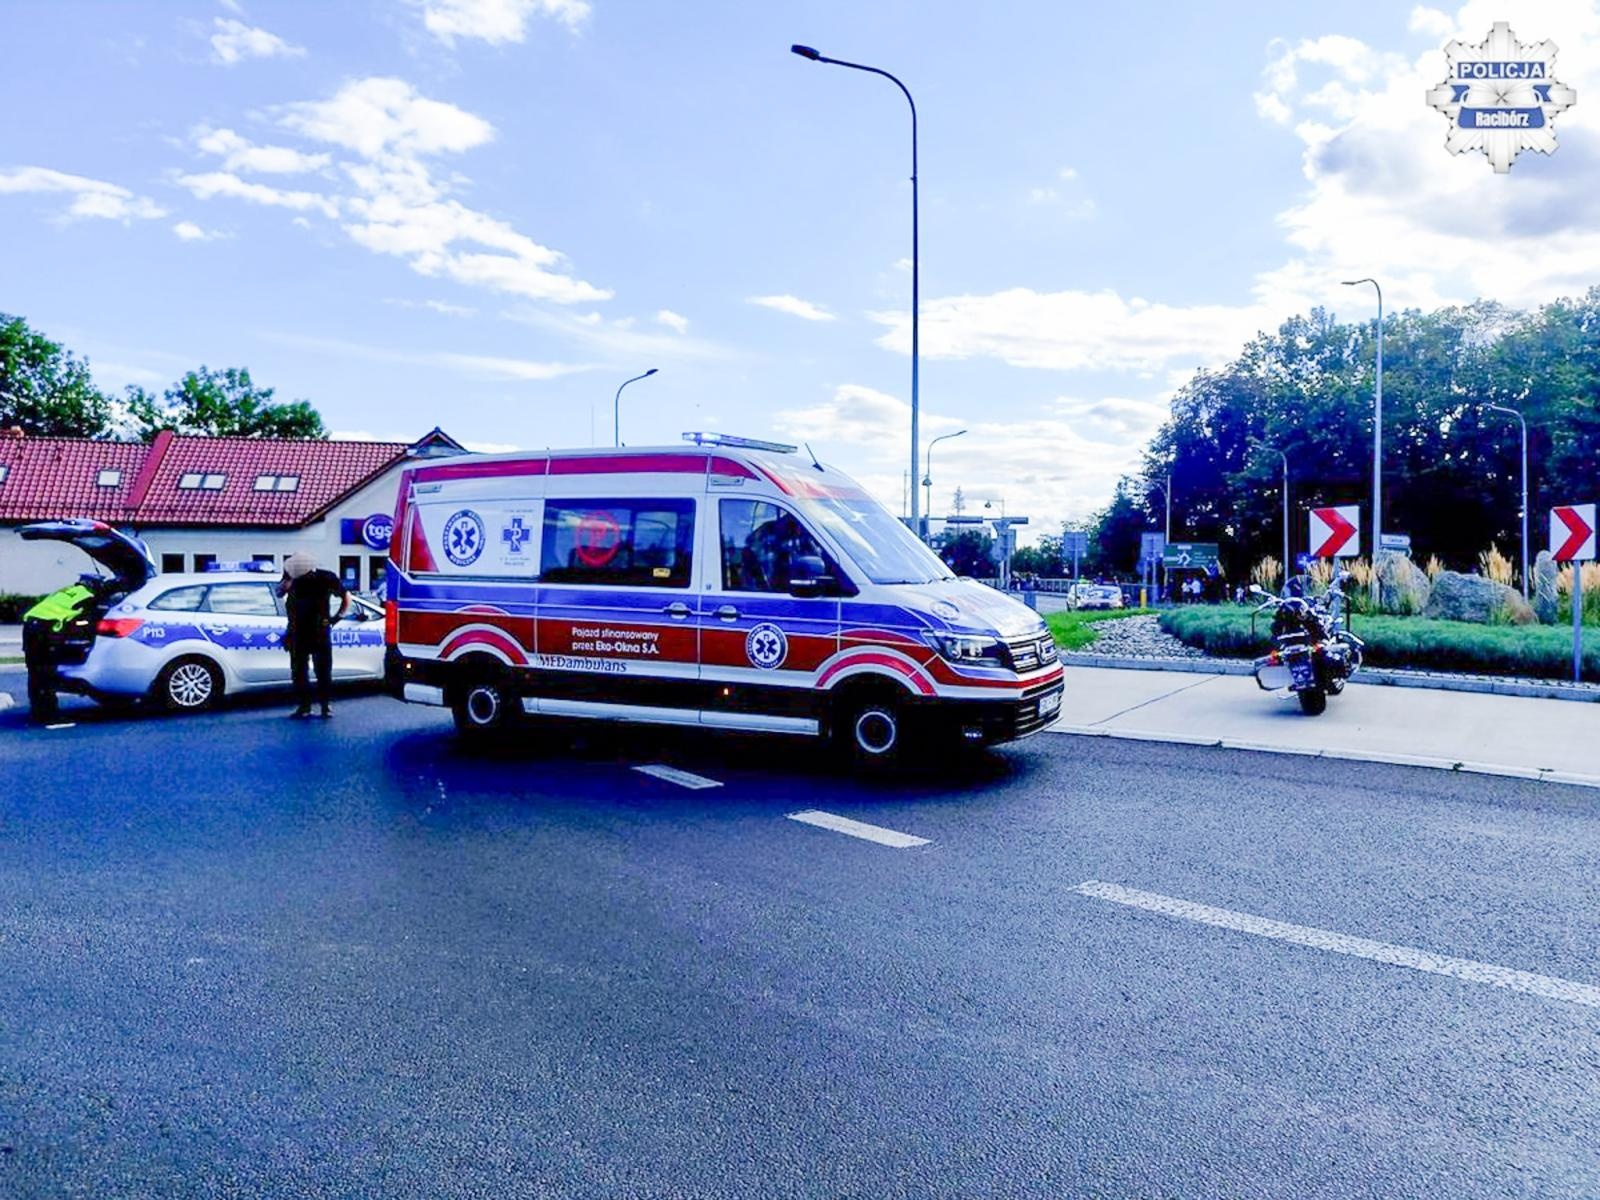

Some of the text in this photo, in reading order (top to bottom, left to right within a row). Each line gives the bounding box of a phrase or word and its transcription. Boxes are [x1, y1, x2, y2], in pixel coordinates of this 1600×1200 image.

[143, 626, 166, 638] P113
[331, 631, 361, 644] LICJA
[571, 626, 659, 642] Pojazd sfinansowany
[571, 640, 660, 654] przez Eko-Okna S.A.
[538, 654, 628, 673] MEDambulans
